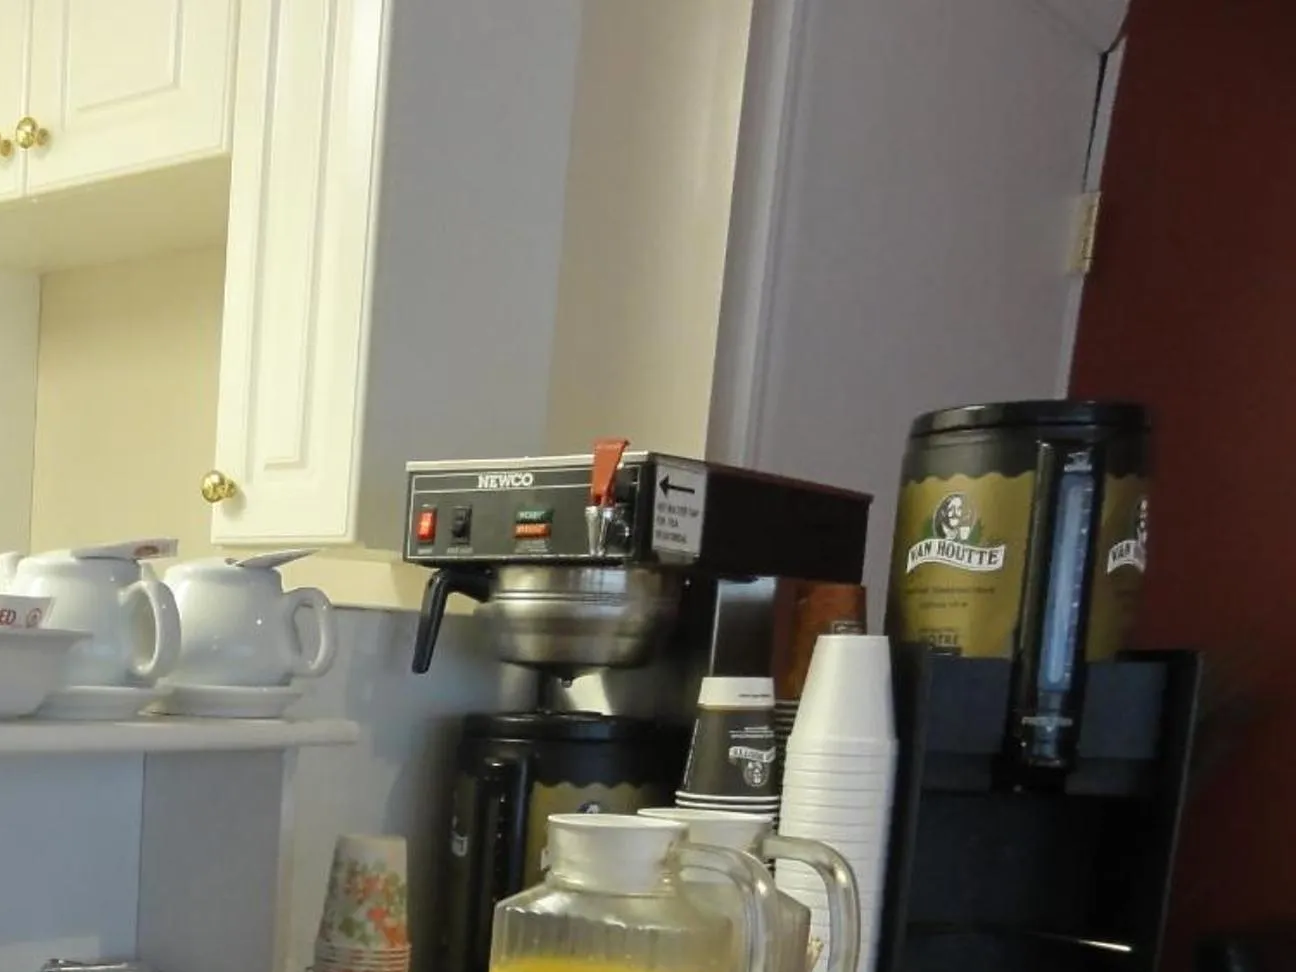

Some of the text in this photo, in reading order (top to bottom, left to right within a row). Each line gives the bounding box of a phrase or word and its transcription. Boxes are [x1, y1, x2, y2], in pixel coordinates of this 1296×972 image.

[478, 472, 534, 489] NEWCO
[910, 541, 999, 566] VAN HOUTTE
